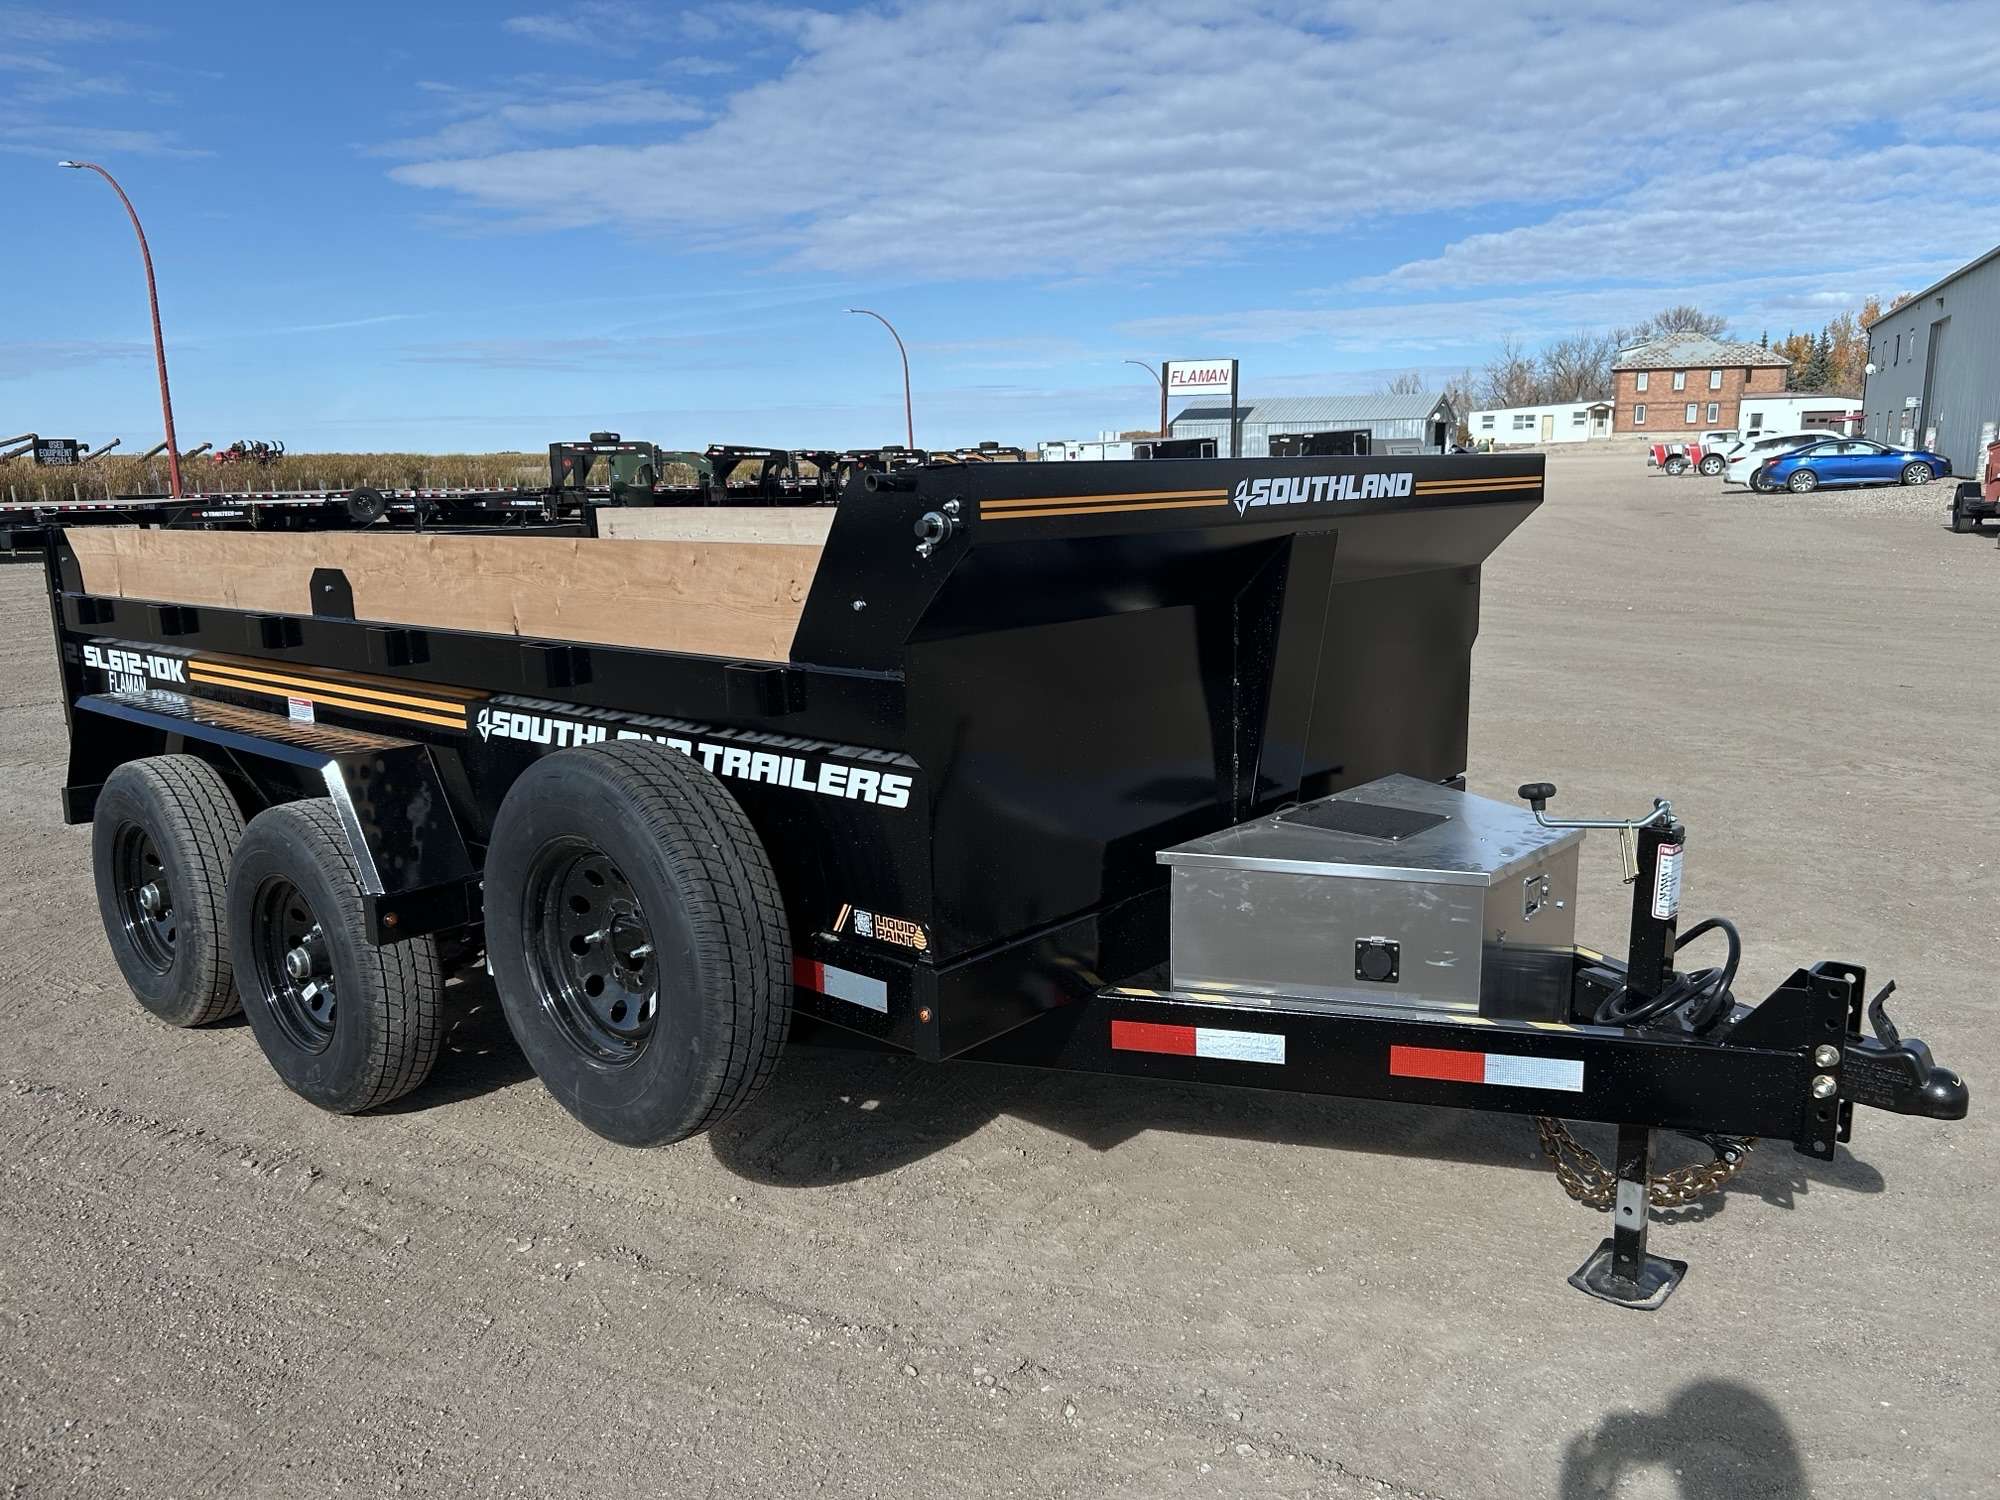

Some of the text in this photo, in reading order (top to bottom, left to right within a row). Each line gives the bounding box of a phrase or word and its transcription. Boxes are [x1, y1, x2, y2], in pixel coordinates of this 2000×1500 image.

[1171, 369, 1229, 384] FLAMAN
[39, 448, 73, 457] EQUIPMENT
[48, 440, 65, 449] USED
[1249, 473, 1413, 507] SOUTHLAND
[83, 645, 186, 684] SL612-10K
[108, 671, 147, 693] FLAMAN
[492, 710, 912, 809] SOUTH TRAILERS
[875, 914, 917, 934] LIQUID
[876, 929, 914, 947] PAINT
